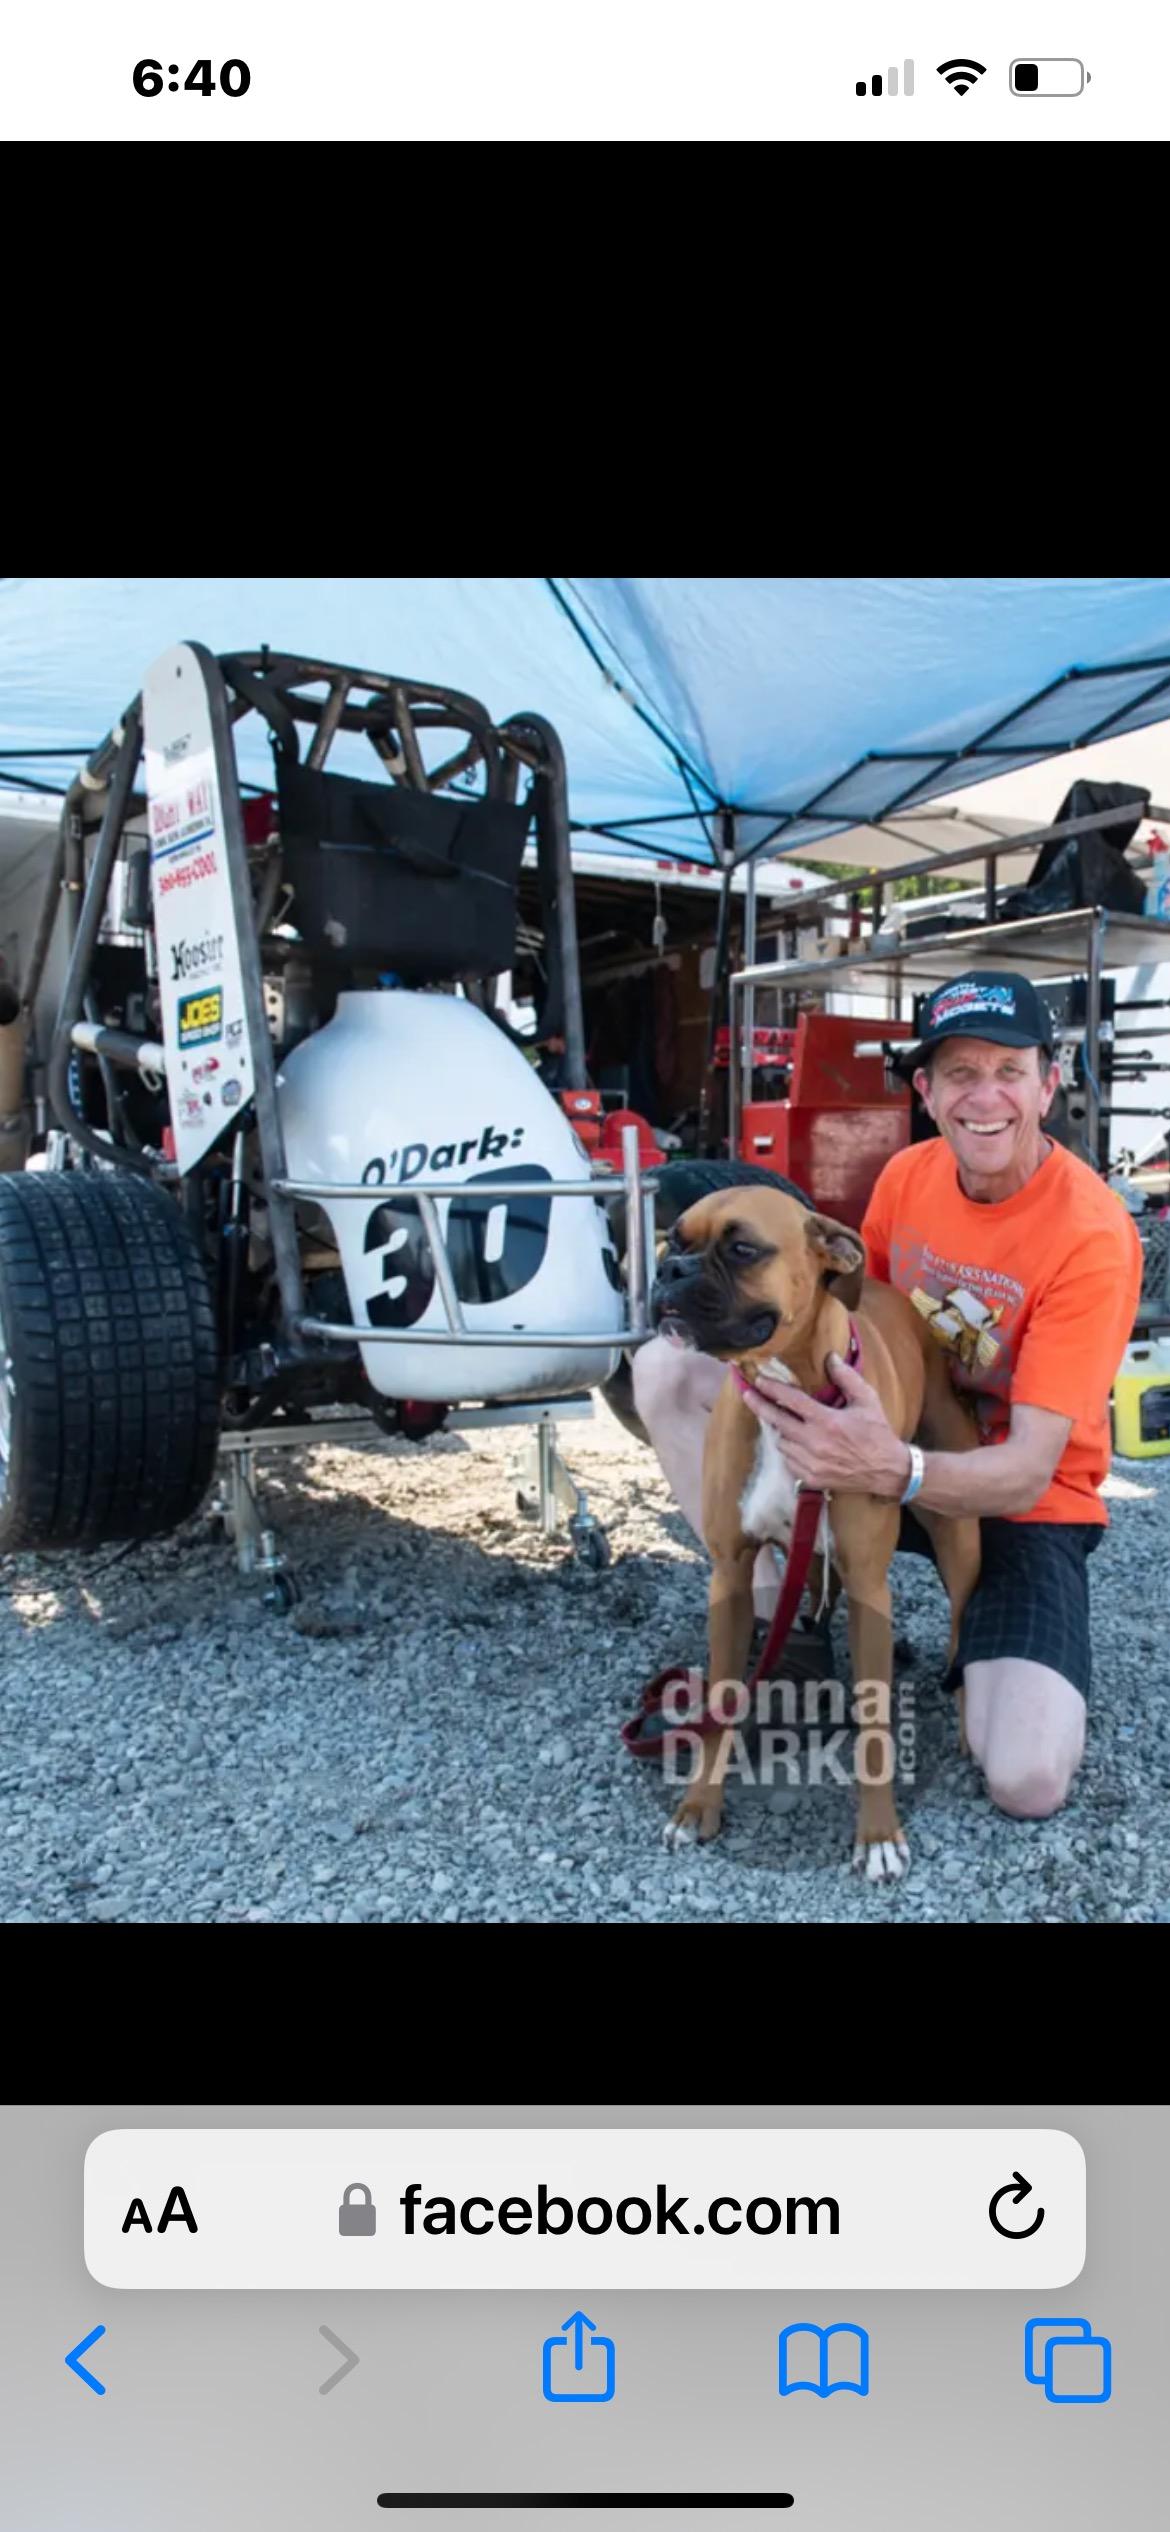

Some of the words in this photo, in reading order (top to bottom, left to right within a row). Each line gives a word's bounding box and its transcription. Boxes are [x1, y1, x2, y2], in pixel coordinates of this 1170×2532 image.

[133, 59, 250, 97] 6:40
[181, 993, 221, 1031] JOES
[363, 1163, 553, 1329] 30
[400, 2184, 839, 2235] facebook.com
